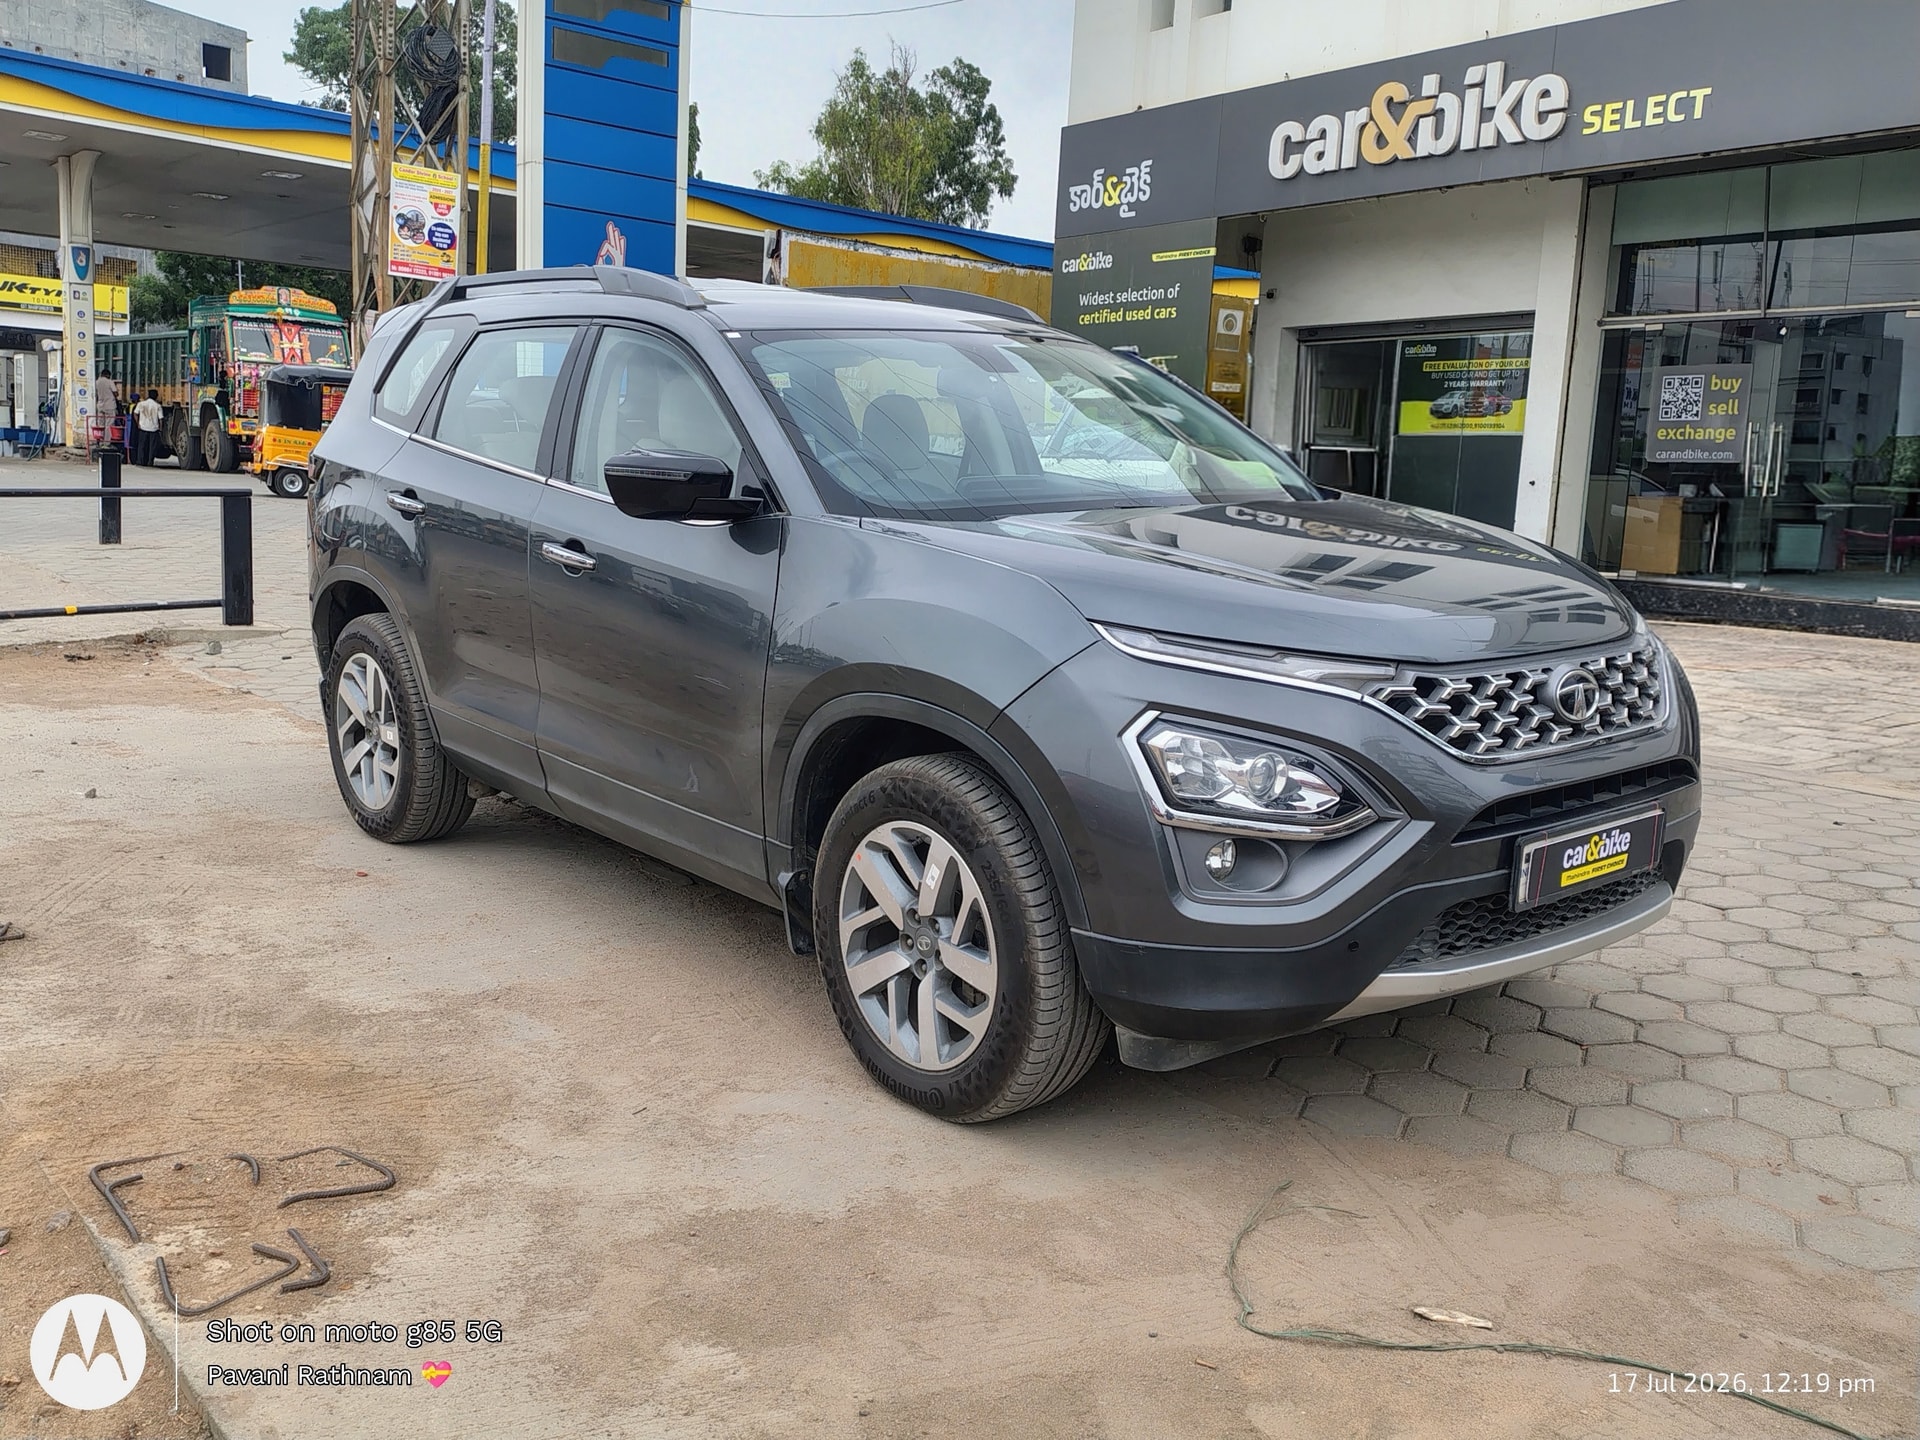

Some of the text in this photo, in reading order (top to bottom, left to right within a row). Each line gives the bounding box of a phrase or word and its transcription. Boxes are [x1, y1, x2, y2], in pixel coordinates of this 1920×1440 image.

[1267, 60, 1713, 180] car&bike SELECT
[437, 173, 453, 181] School
[1068, 159, 1153, 218] కార్&బైక్
[429, 194, 456, 203] ADMISSIONS
[1062, 251, 1113, 273] car&bike
[1079, 283, 1181, 306] Widest selection of
[1079, 305, 1177, 325] certified used cars
[1404, 344, 1437, 355] car&bike
[1424, 360, 1529, 371] FREE EVALUATION OF YOUR CAR
[1431, 371, 1444, 379] BUY
[1444, 371, 1460, 379] USED
[1473, 370, 1488, 378] AND
[1488, 370, 1500, 378] GET
[1501, 369, 1511, 378] UP
[1443, 380, 1448, 388] 2
[1469, 379, 1506, 388] WARRANTY
[1711, 374, 1742, 393] buy
[1708, 398, 1739, 415] sell
[1657, 424, 1736, 443] exchange
[1656, 449, 1733, 459] carandbike.com
[1563, 829, 1631, 869] car&bike
[1565, 858, 1625, 881] Mahindra FIRST CHOICE
